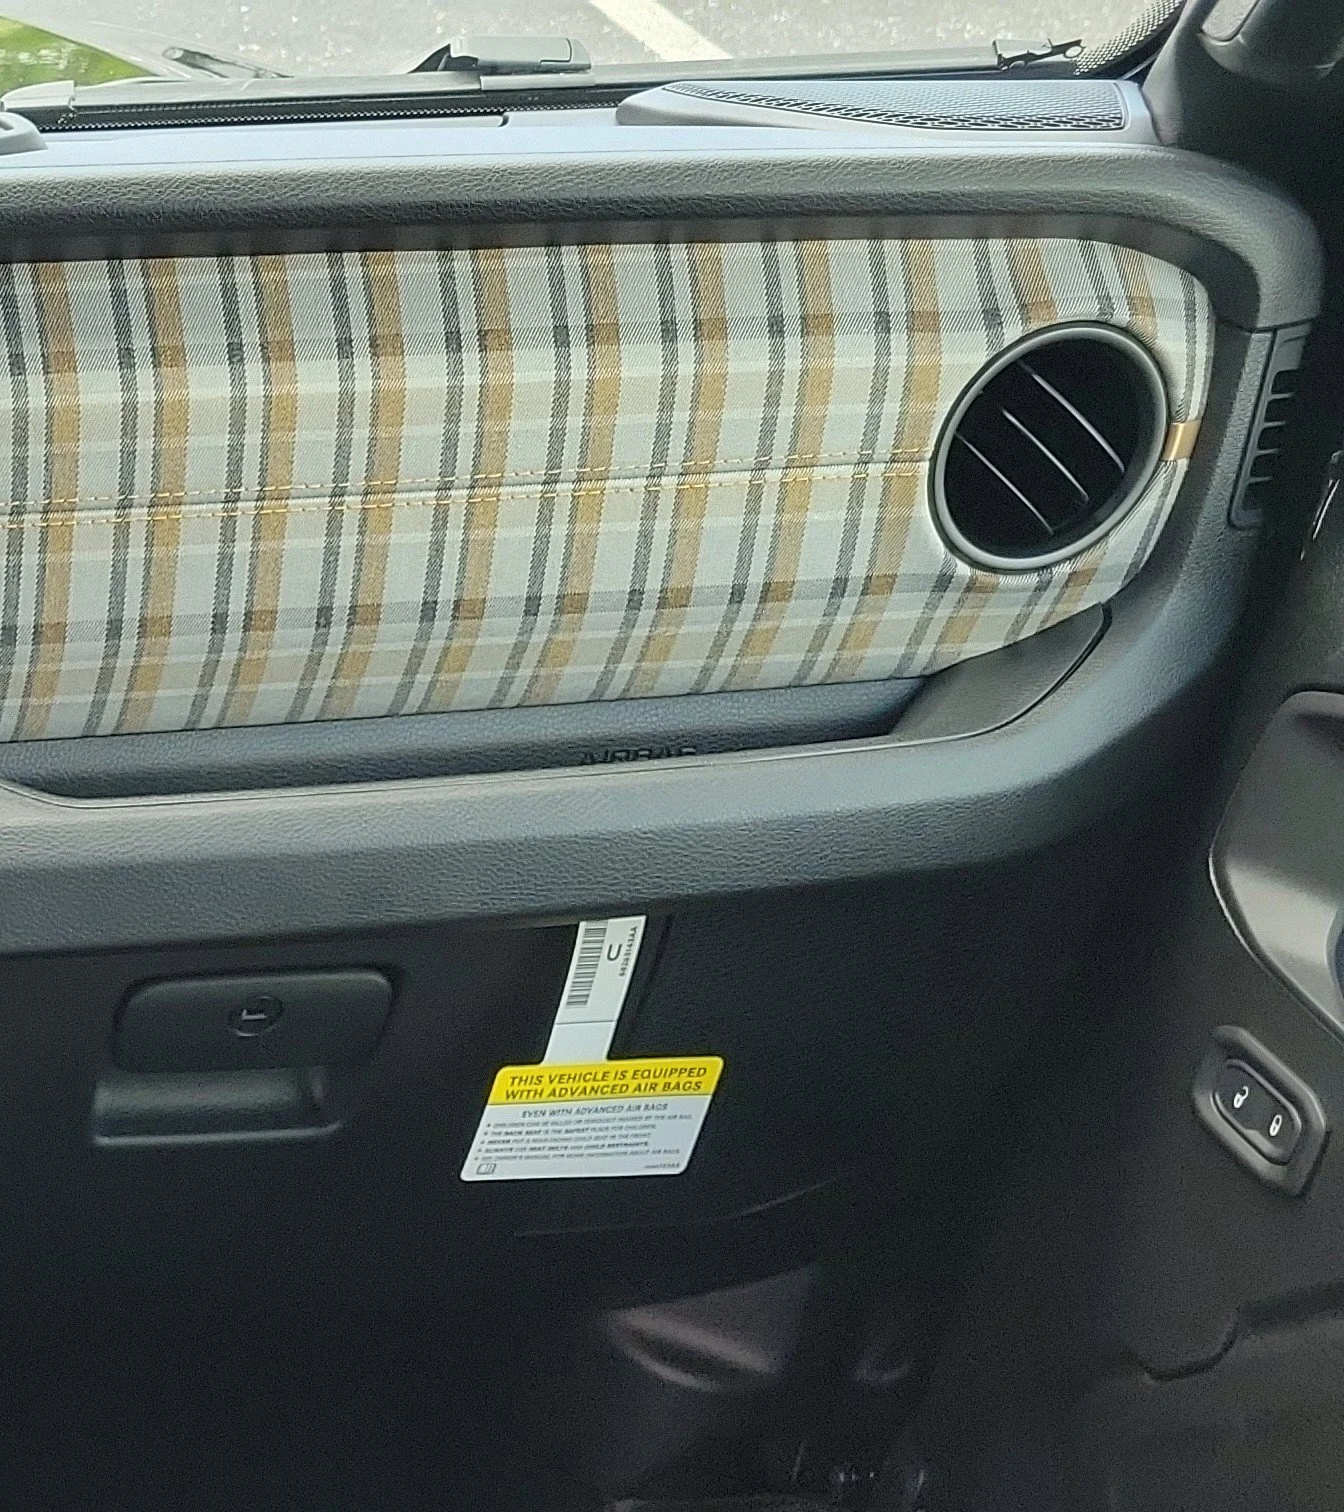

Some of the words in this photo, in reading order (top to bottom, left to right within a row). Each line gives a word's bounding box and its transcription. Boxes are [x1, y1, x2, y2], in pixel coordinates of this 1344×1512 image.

[510, 1076, 544, 1087] THIS
[548, 1071, 610, 1085] VEHICLE
[613, 1069, 627, 1081] IS
[633, 1067, 707, 1080] EQUIPPED
[505, 1087, 543, 1100] WITH
[547, 1085, 629, 1098] ADVANCED
[633, 1081, 657, 1093] AIR
[662, 1081, 702, 1092] BAGS
[522, 1110, 546, 1118] EVEN
[549, 1108, 572, 1117] WITH
[575, 1106, 623, 1115] ADVANCED
